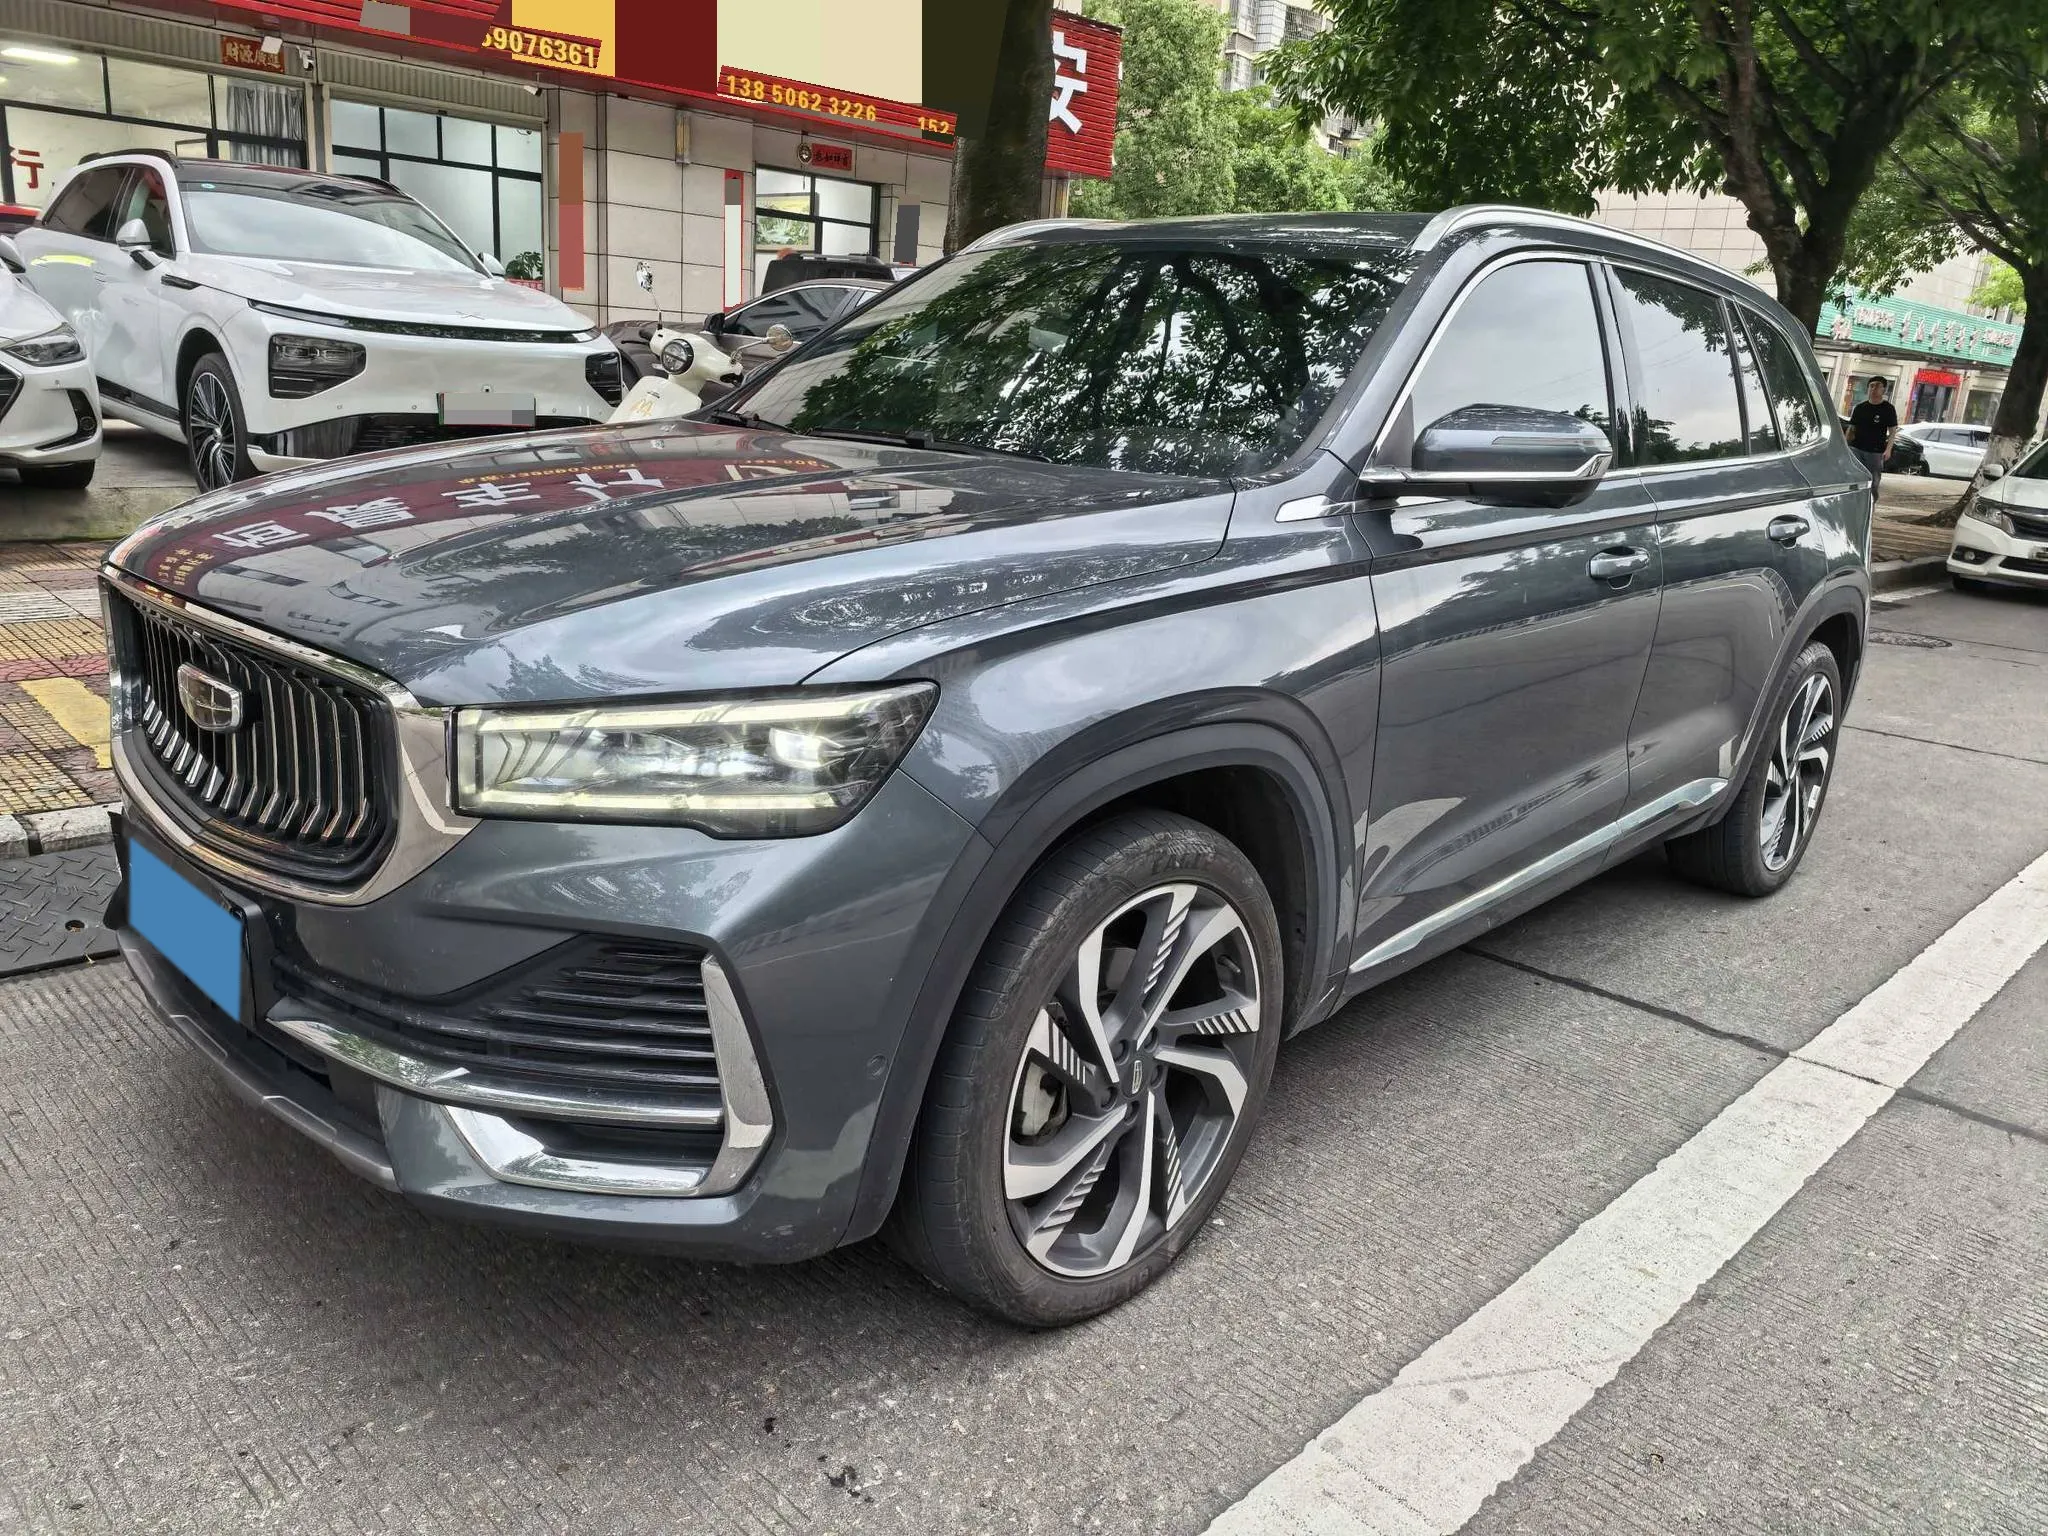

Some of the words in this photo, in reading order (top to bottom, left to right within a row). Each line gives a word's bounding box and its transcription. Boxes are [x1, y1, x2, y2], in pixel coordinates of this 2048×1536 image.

[727, 74, 765, 100] 138
[772, 84, 822, 112] 5062
[828, 96, 876, 122] 3226
